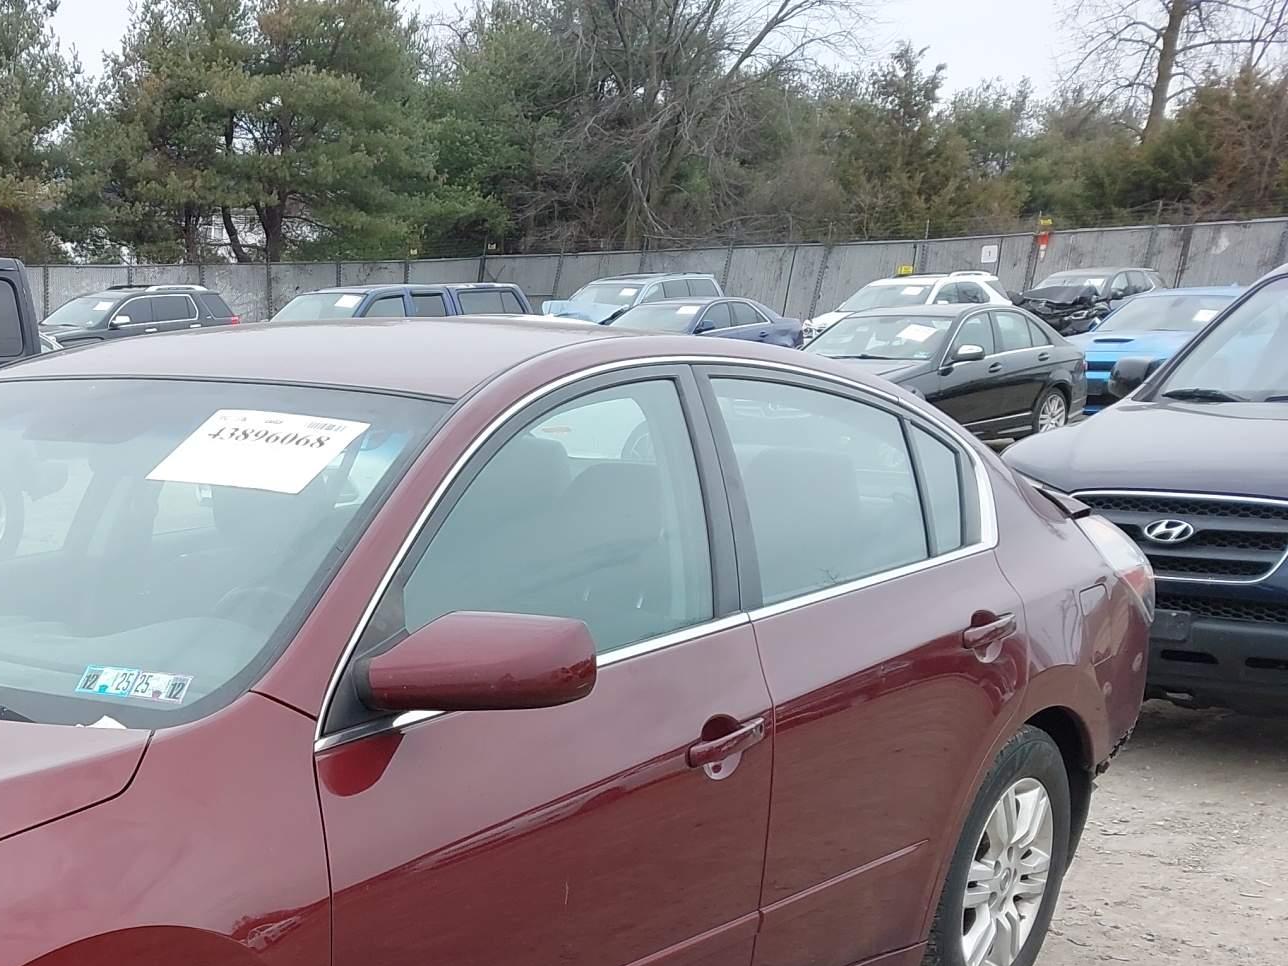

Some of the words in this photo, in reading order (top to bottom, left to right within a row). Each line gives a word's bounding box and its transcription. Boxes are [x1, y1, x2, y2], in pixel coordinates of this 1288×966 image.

[208, 427, 330, 448] 43896068
[82, 673, 99, 690] 12
[115, 672, 134, 691] 25
[134, 674, 153, 693] 25
[167, 682, 186, 699] 12
